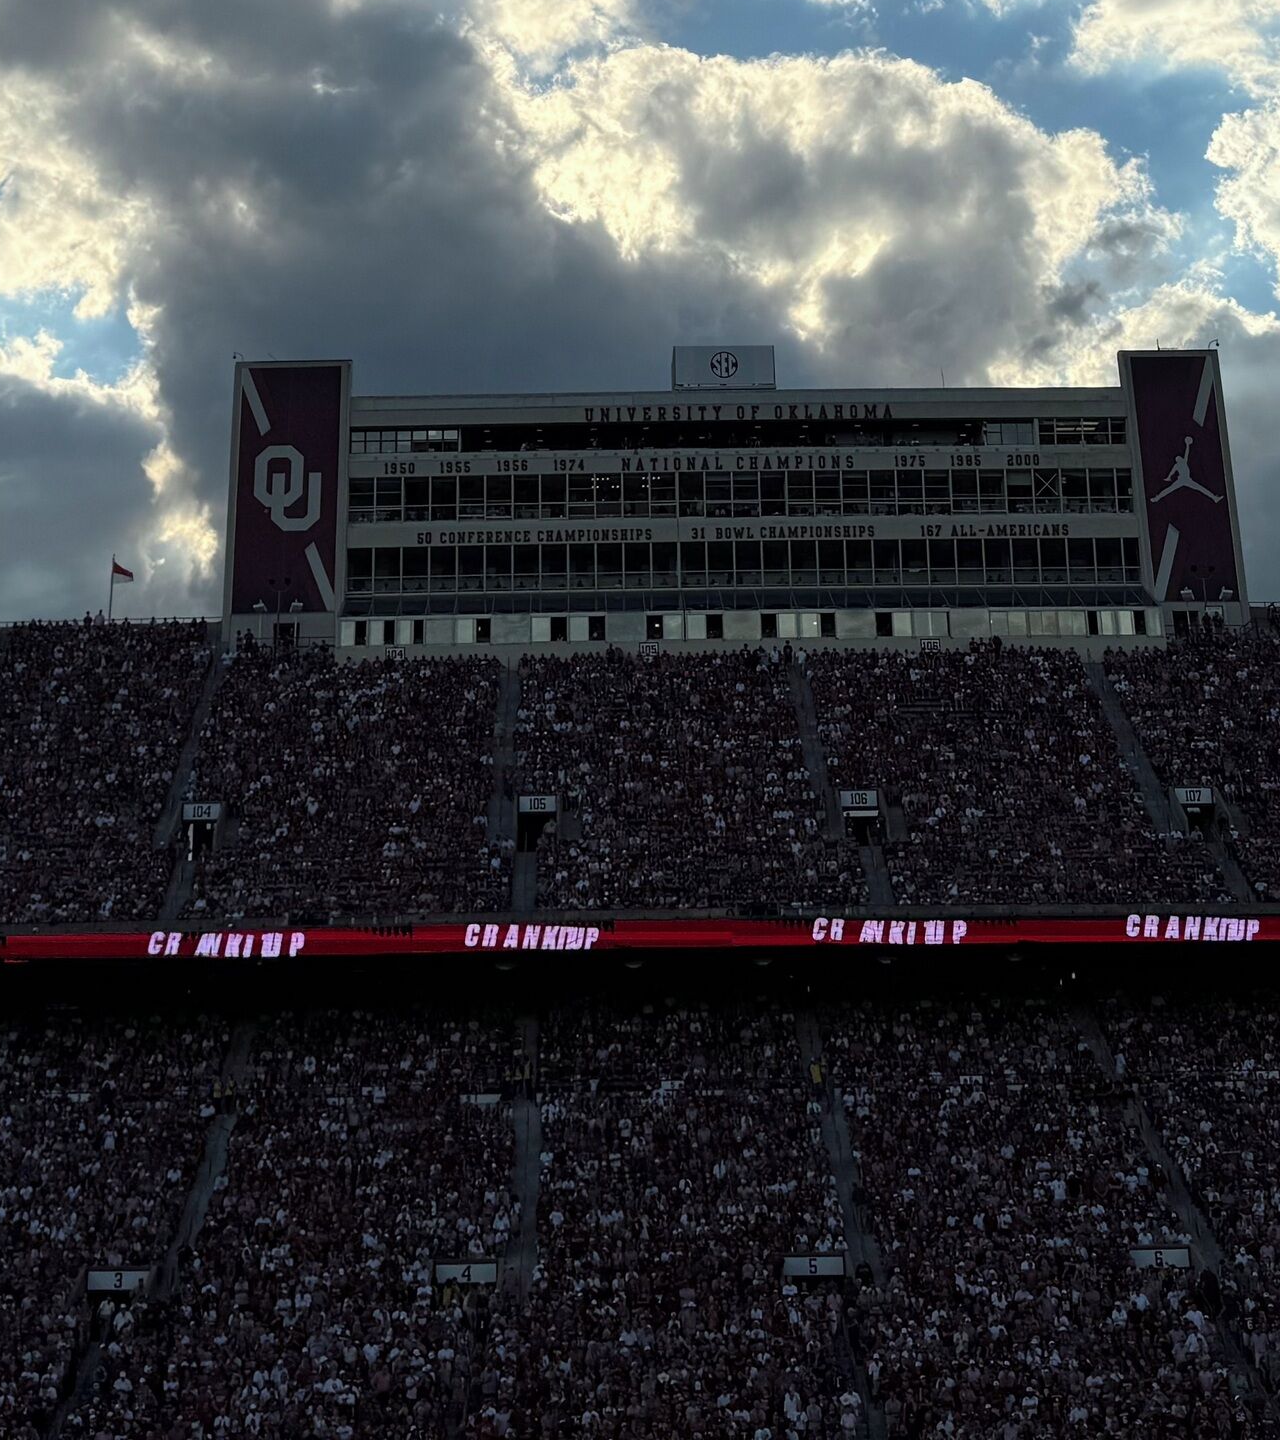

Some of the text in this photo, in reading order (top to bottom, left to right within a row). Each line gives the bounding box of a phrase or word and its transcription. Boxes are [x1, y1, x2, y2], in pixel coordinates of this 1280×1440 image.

[711, 352, 738, 378] SEC
[585, 404, 893, 422] UNIVERSITY OF OKLAHOMA
[384, 454, 1040, 474] 1950 1955 1956 1974 NATIONAL CHAMPIONS 1975 1985 2000
[253, 444, 322, 531] OU
[417, 528, 652, 545] 50 CONFERENCE CHAMPIONSHIPS
[691, 525, 875, 539] 31 BOWL CHAMPIONSHIPS
[921, 524, 1069, 537] 167 ALL-AMERICANS
[387, 649, 403, 659] 104
[641, 645, 657, 654] 105
[850, 793, 868, 804] 106
[1185, 790, 1202, 801] 107
[192, 805, 211, 817] 104
[529, 798, 546, 810] 105
[809, 1258, 817, 1273] 5
[1155, 1251, 1163, 1266] 6
[114, 1273, 123, 1288] 3
[462, 1265, 472, 1281] 4
